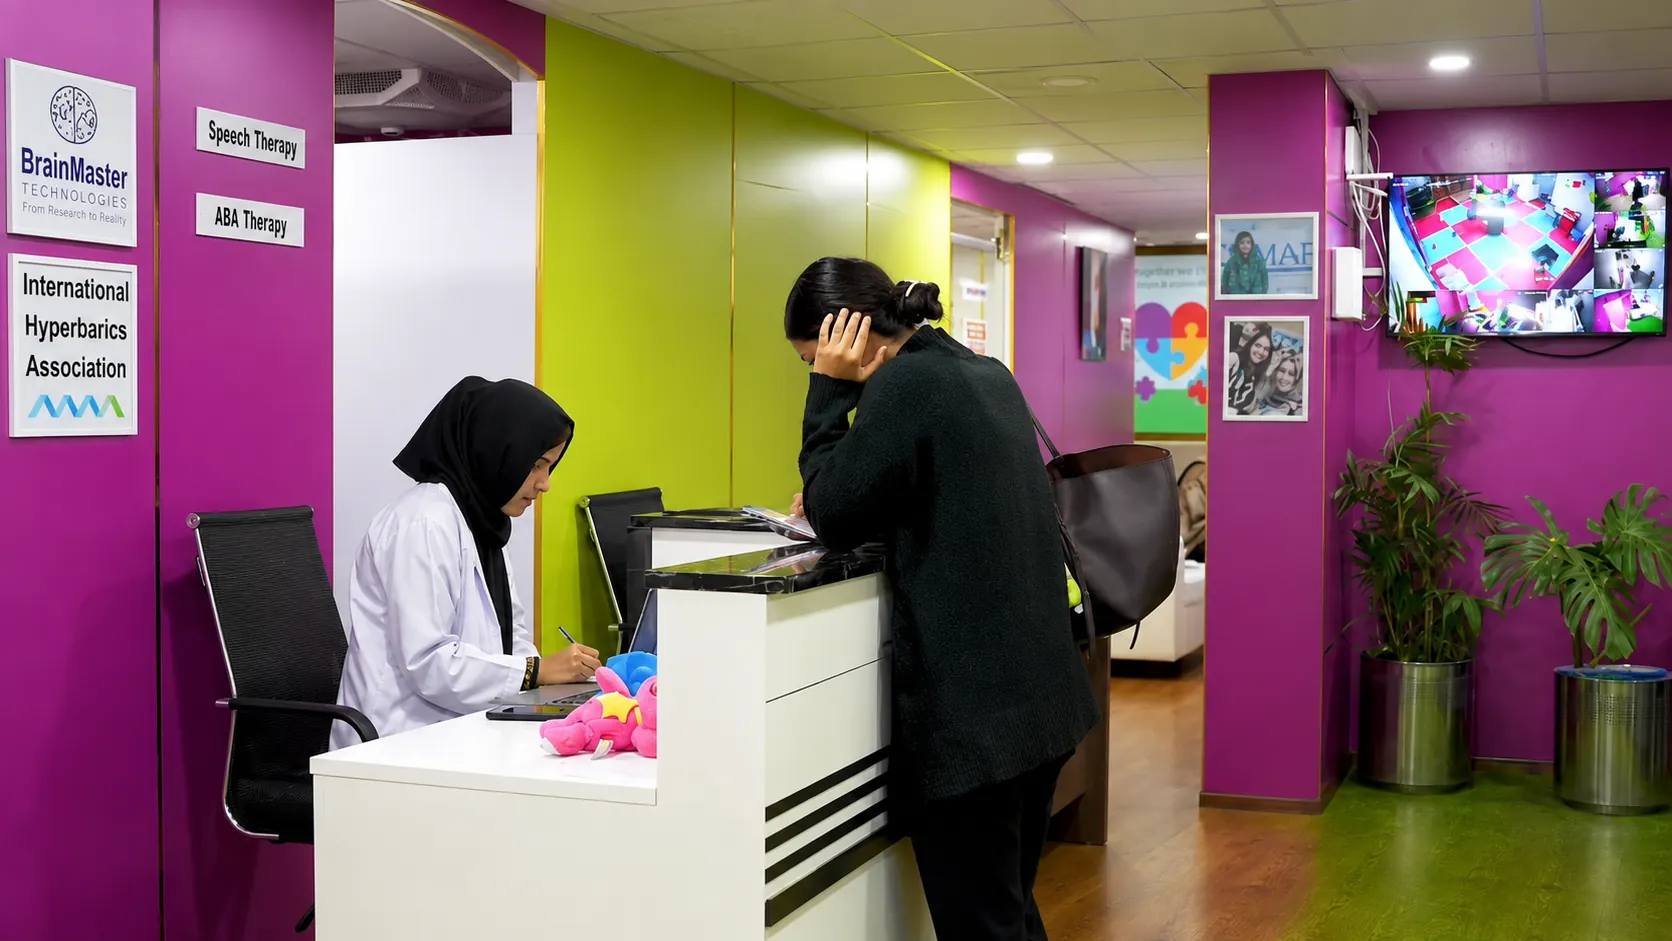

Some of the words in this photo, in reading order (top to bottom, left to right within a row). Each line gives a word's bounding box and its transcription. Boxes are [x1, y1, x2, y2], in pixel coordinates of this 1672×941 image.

[208, 119, 250, 147] Speech
[254, 129, 298, 161] Therapy
[21, 146, 128, 189] BrainMaster
[22, 182, 127, 209] TECHNOLOGIES
[22, 202, 45, 214] From
[48, 205, 86, 219] Research
[89, 210, 97, 221] to
[100, 212, 127, 227] Reality
[215, 206, 239, 228] ABA
[243, 209, 287, 239] Therapy
[23, 272, 129, 302] International
[25, 313, 127, 343] Hyperbarics
[25, 354, 127, 379] Association
